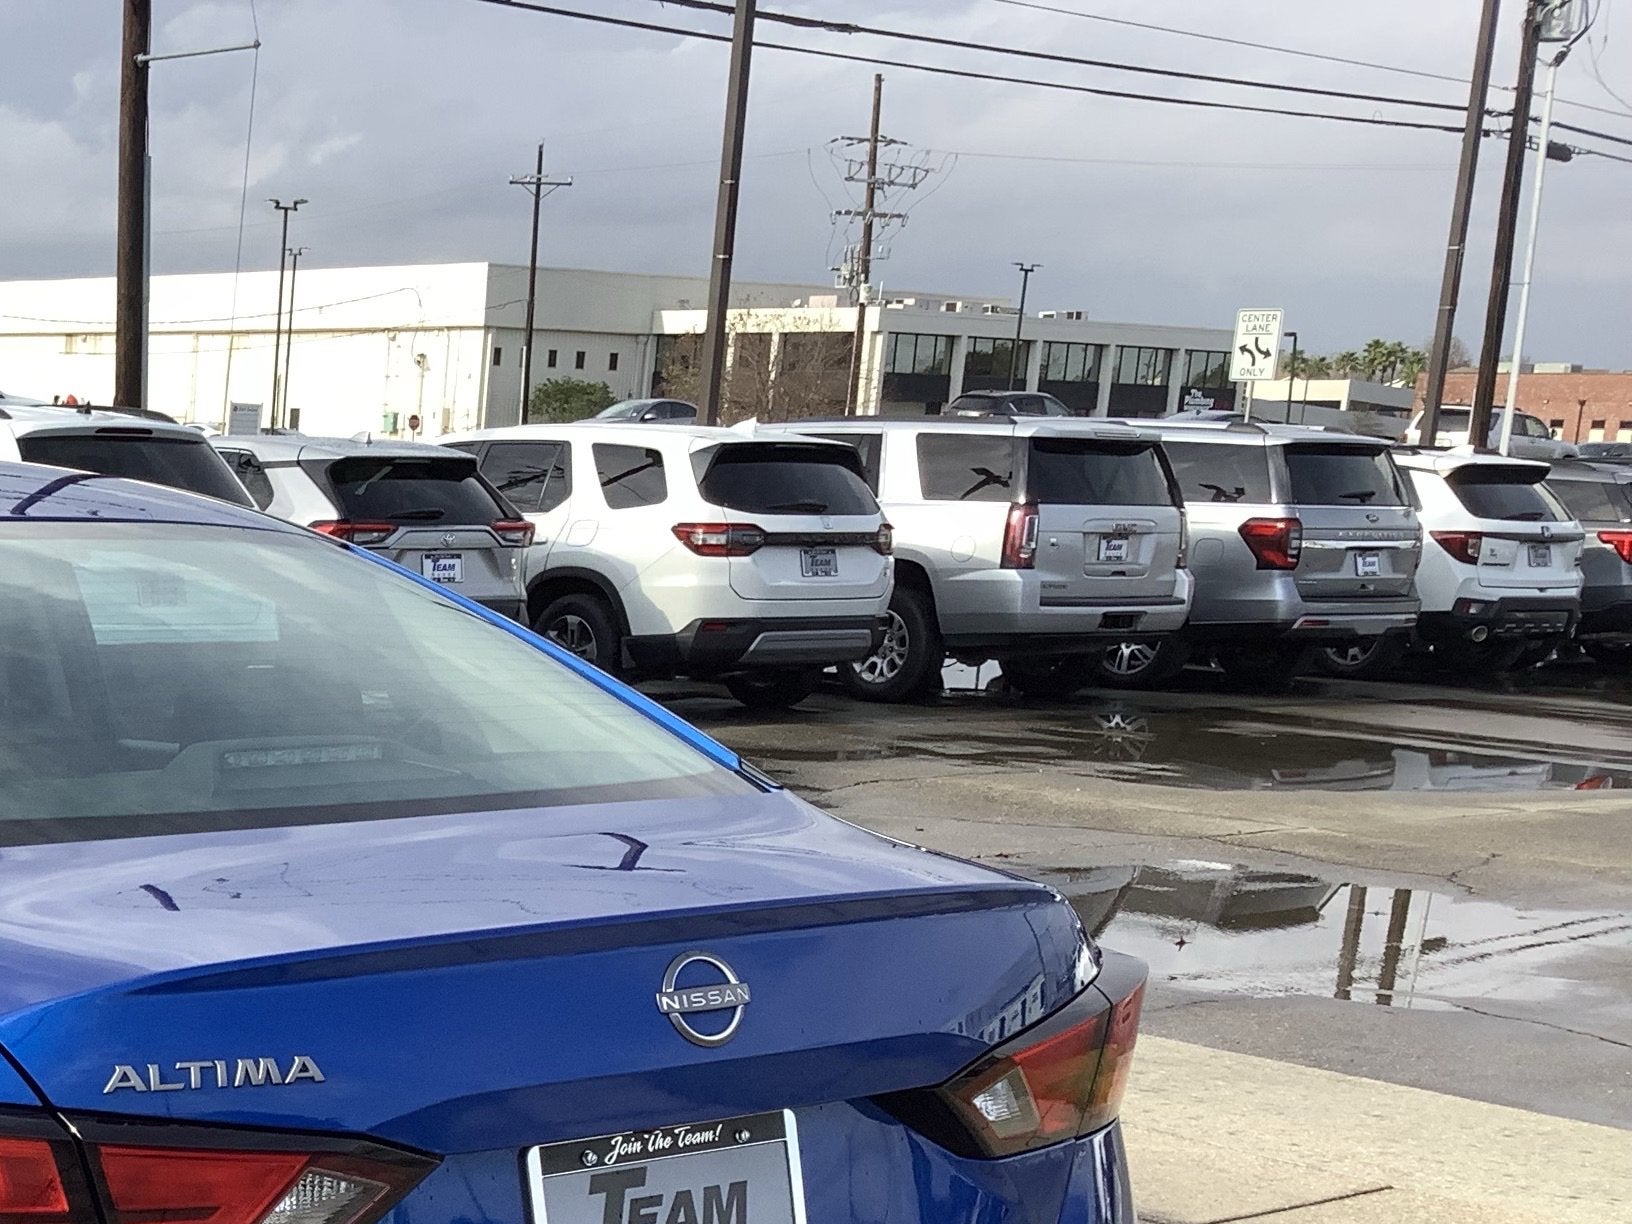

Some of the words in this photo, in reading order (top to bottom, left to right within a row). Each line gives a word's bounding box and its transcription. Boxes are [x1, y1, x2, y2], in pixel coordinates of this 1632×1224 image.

[1241, 314, 1278, 323] CENTER
[1245, 323, 1271, 333] LANE
[1239, 368, 1265, 377] ONLY
[431, 557, 456, 571] TEAM
[661, 987, 750, 1011] NISSAN
[103, 1055, 326, 1094] ALTIMA
[604, 1136, 644, 1165] Join
[673, 1124, 723, 1148] Team!
